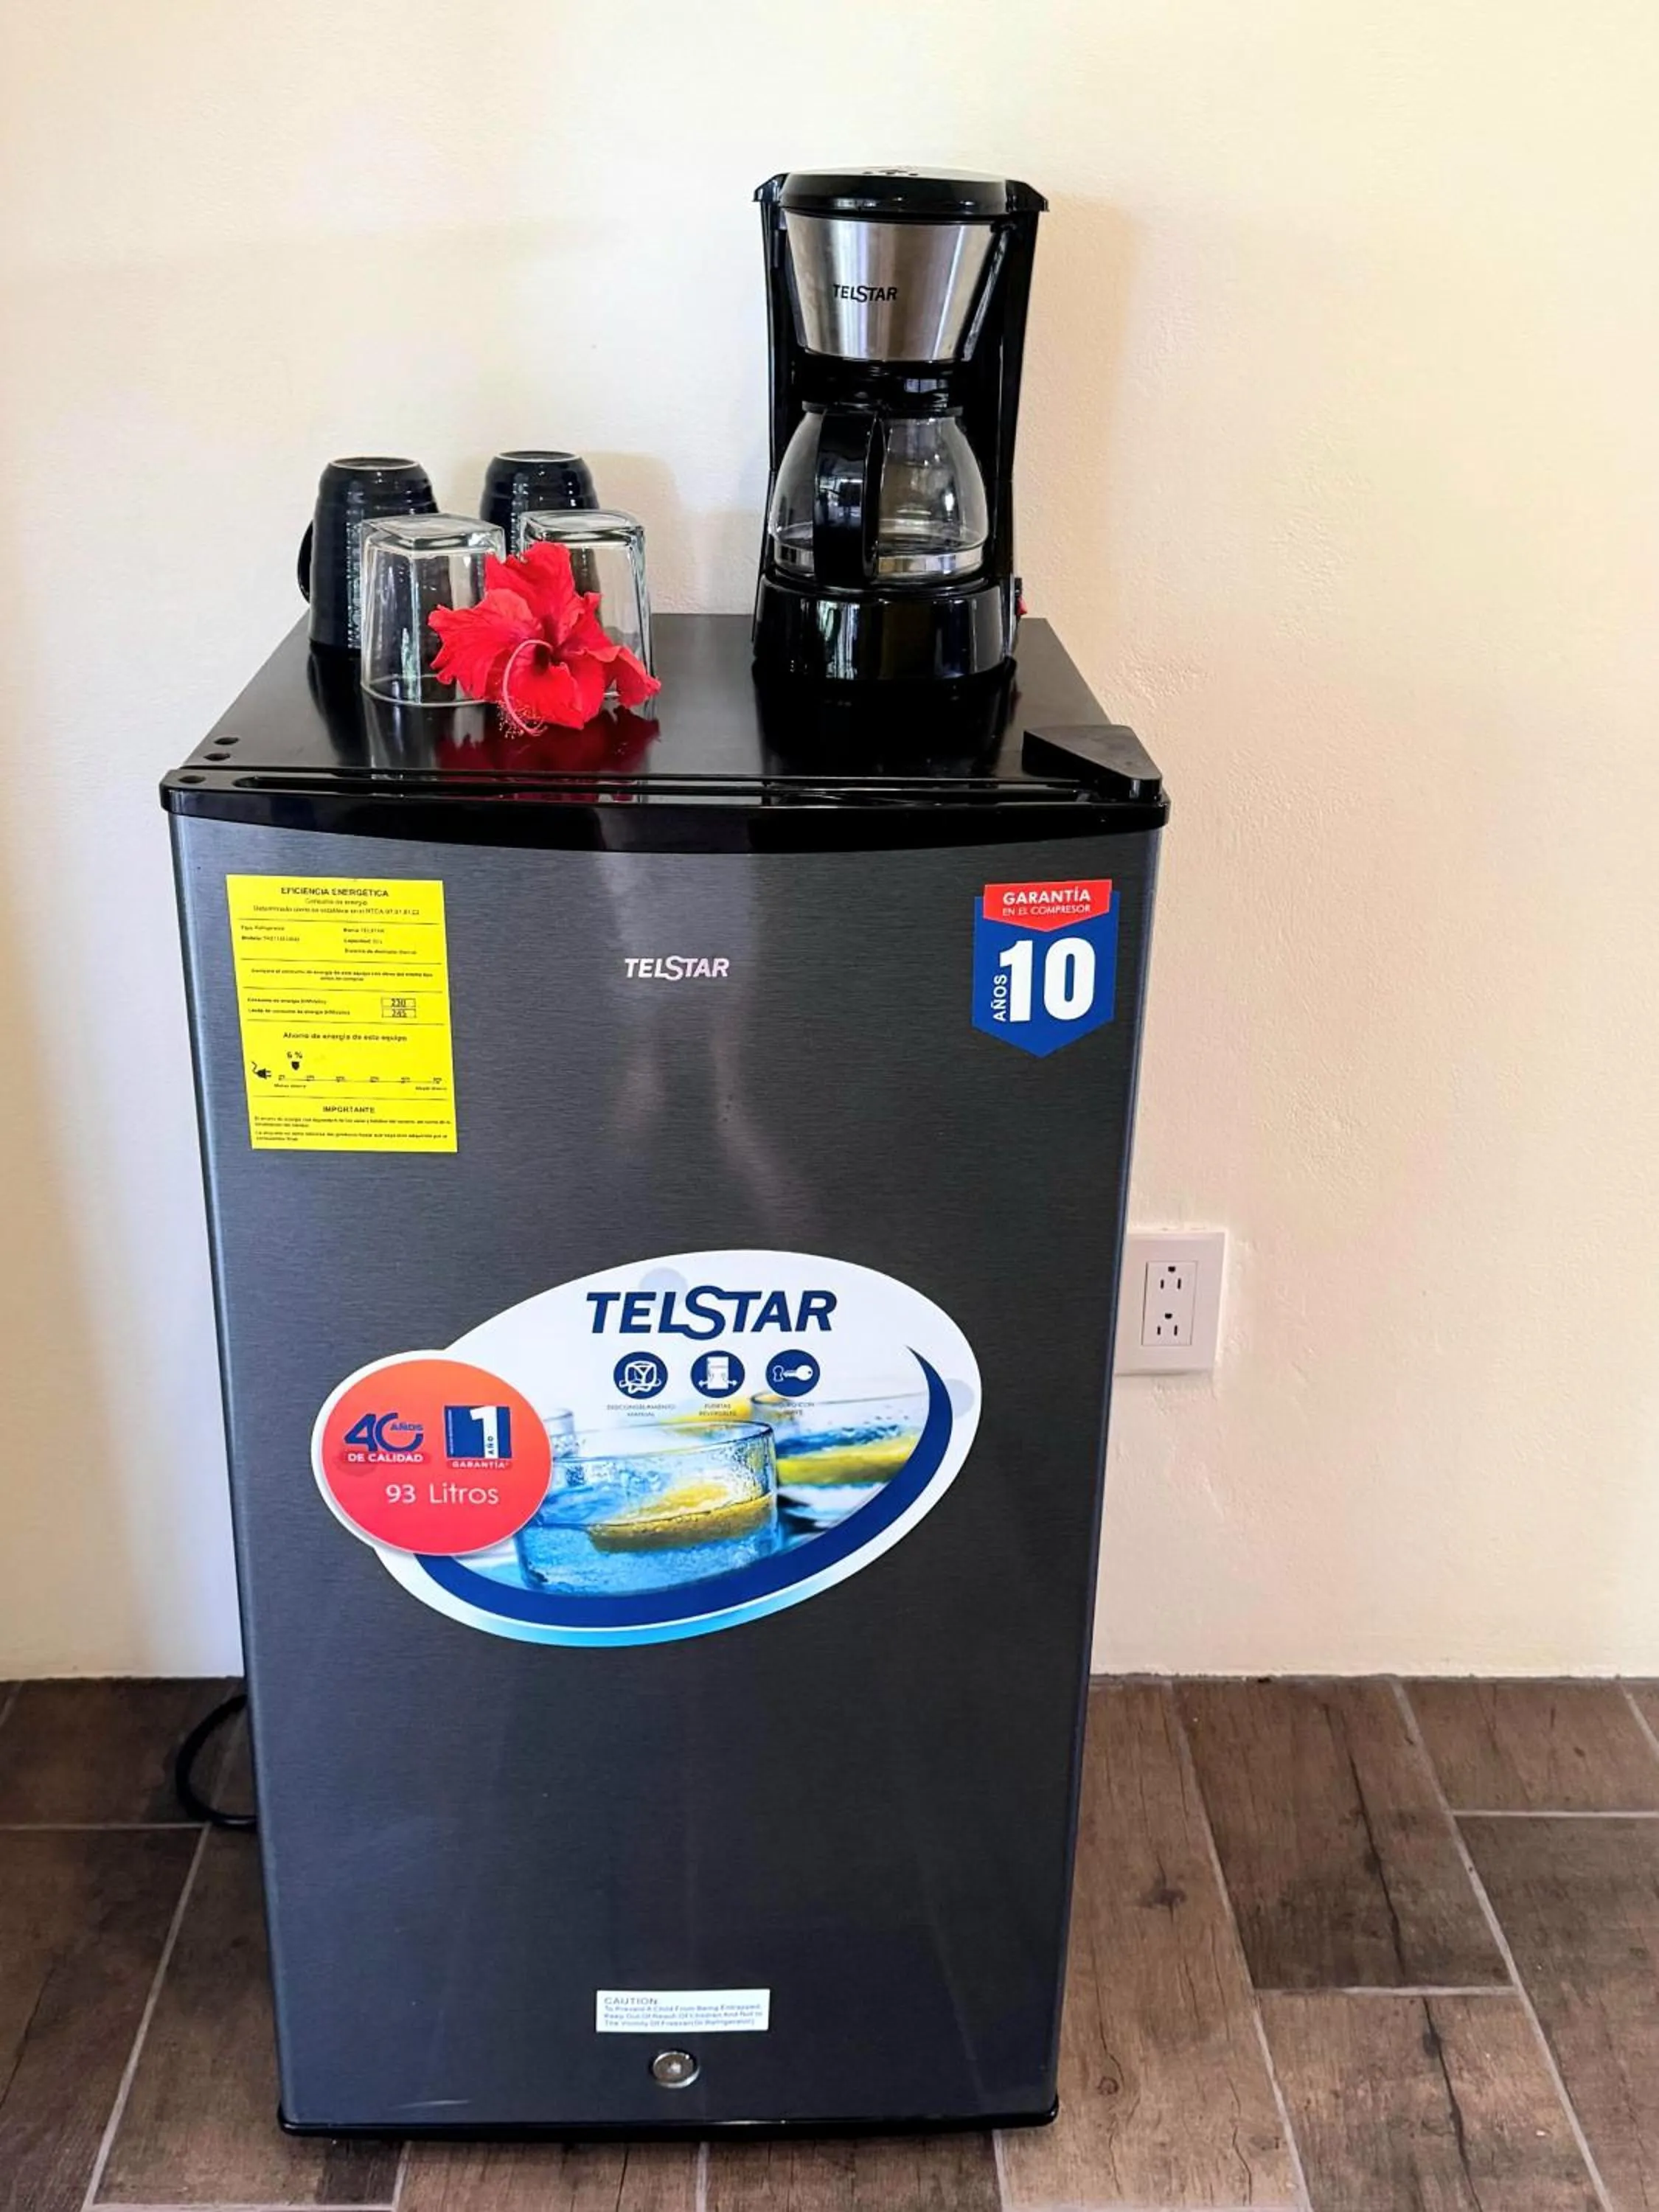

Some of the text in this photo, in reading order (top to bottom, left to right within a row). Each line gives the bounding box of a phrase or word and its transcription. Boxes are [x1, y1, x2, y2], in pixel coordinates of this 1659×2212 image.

[832, 283, 897, 302] TELSTAR
[1003, 886, 1091, 905] GARANTÍA
[1003, 904, 1091, 916] EN EL COMPRESOR
[625, 956, 730, 981] TELSTAR
[1000, 937, 1096, 1023] 10
[990, 974, 1008, 1022] AÑOS
[586, 1285, 838, 1340] TELSTAR
[390, 1422, 424, 1431] AÑOS
[470, 1406, 498, 1459] 1
[348, 1453, 423, 1463] DE CALIDAD
[452, 1461, 506, 1469] GARANTÍA
[386, 1483, 498, 1504] 93 Litros
